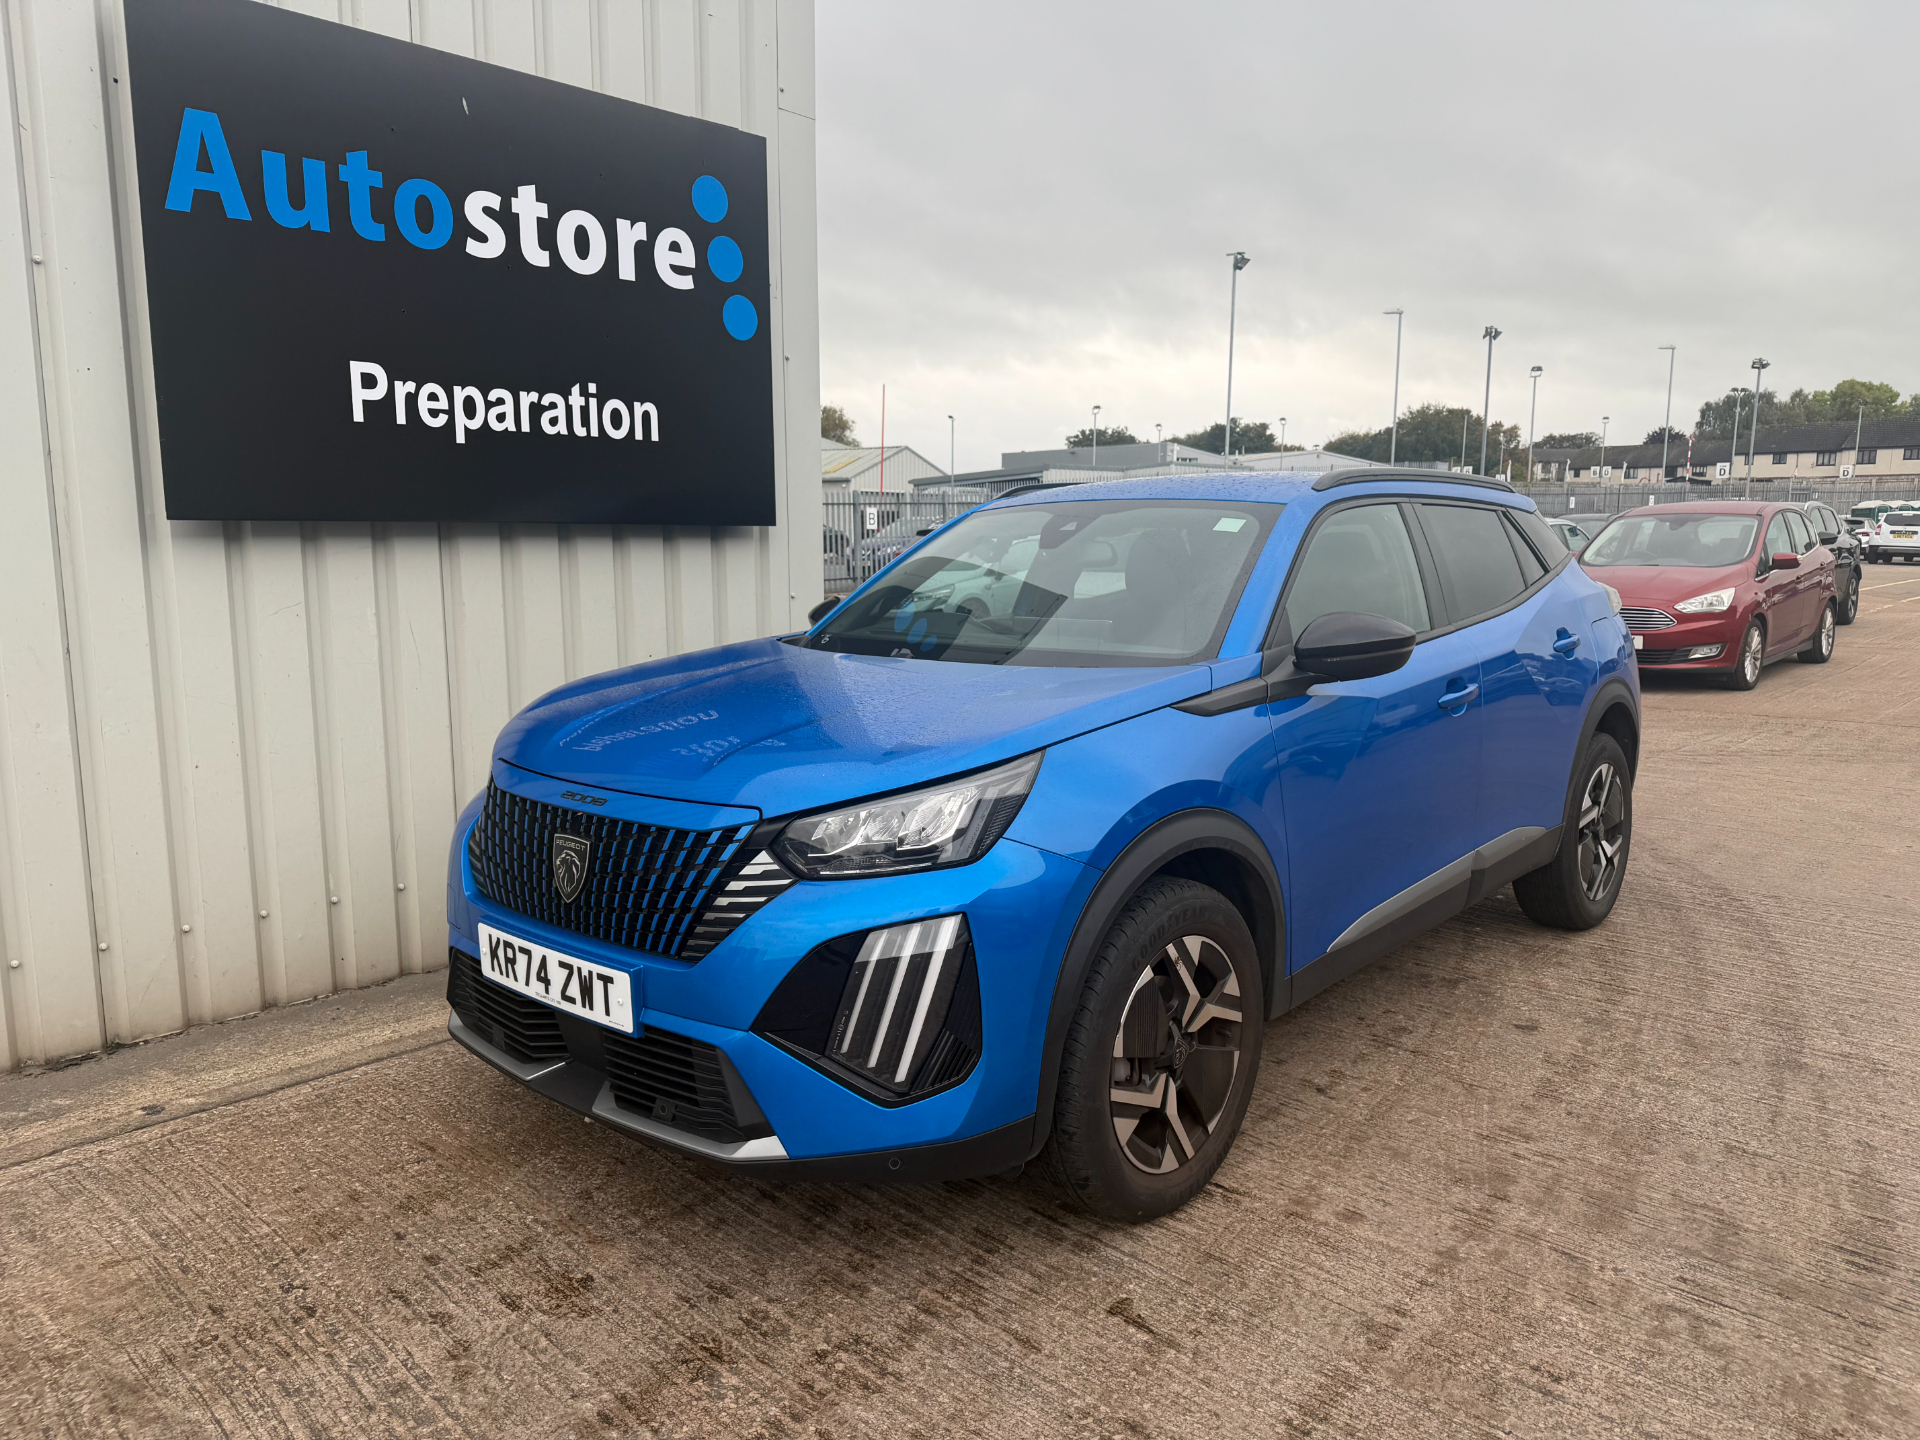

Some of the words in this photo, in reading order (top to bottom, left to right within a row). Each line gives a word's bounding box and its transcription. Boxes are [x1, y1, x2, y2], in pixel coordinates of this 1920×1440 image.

[165, 107, 696, 290] Autostore
[349, 360, 660, 444] Preparation
[868, 512, 876, 526] B
[561, 790, 608, 807] 2008
[556, 840, 586, 851] PEUGEOT
[488, 933, 552, 995] KR74
[558, 959, 614, 1017] ZWT
